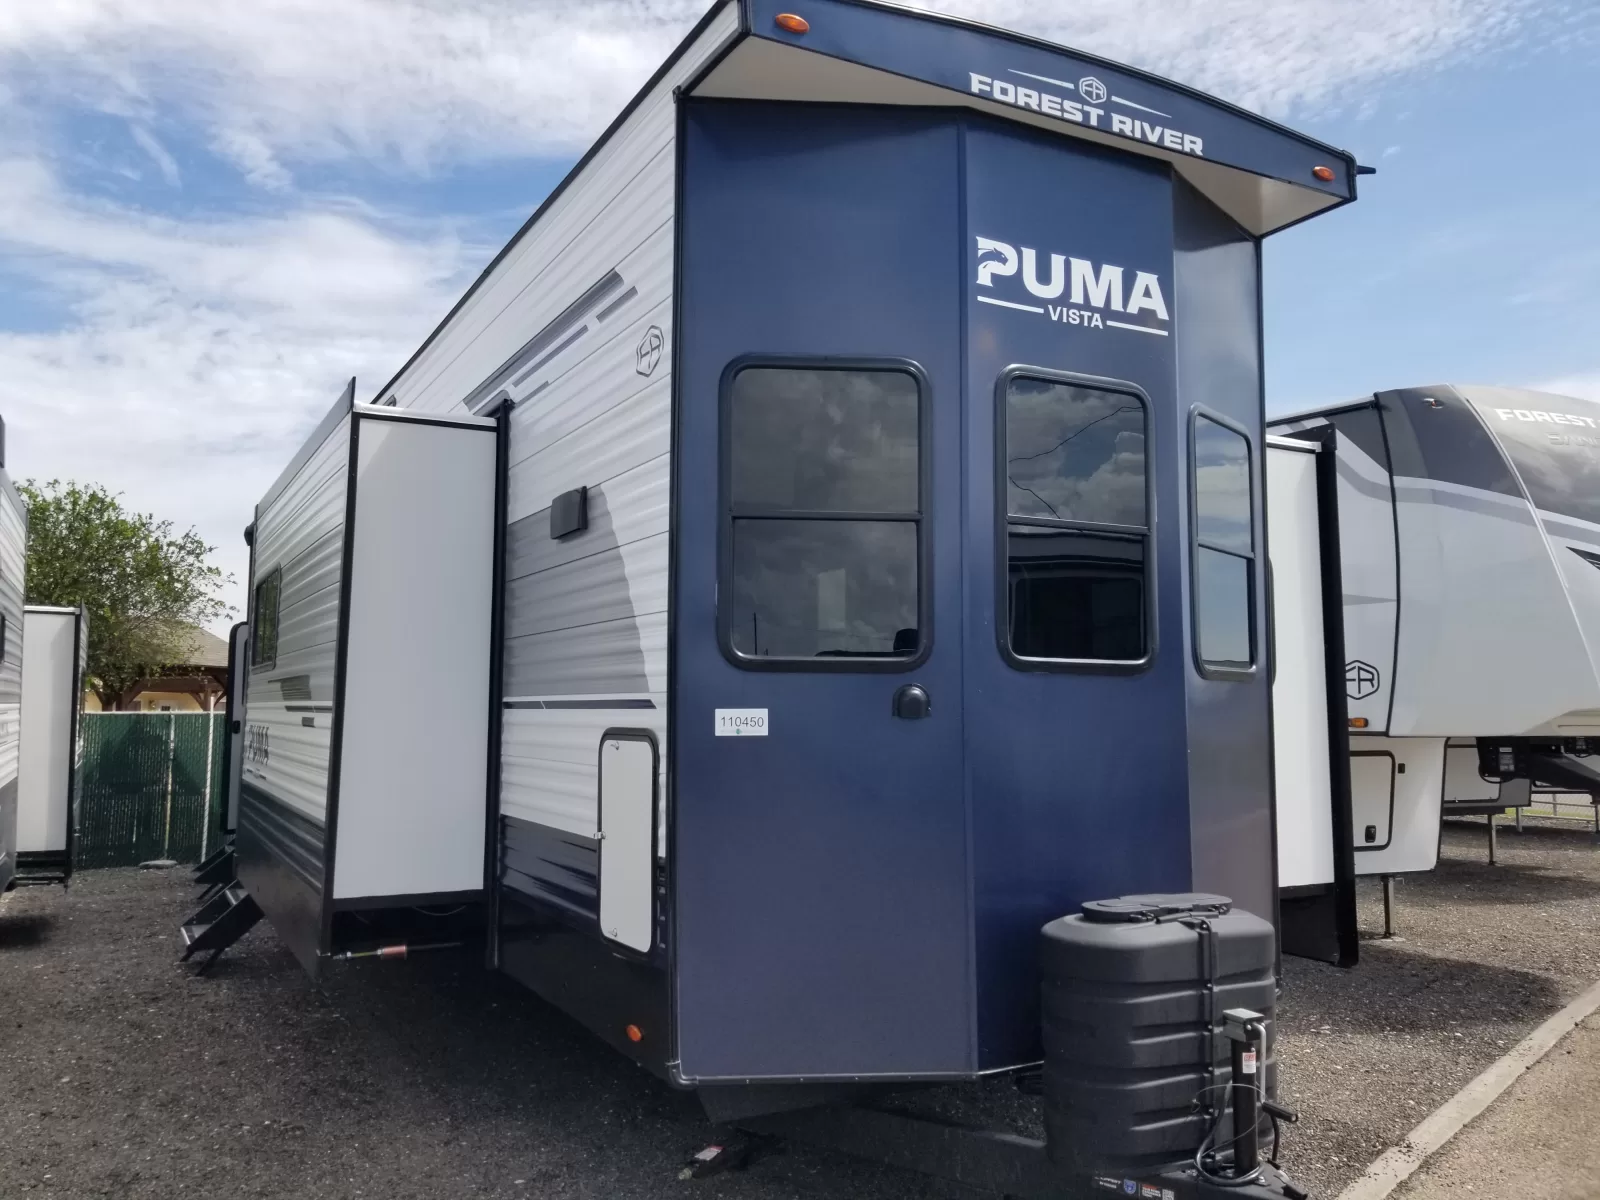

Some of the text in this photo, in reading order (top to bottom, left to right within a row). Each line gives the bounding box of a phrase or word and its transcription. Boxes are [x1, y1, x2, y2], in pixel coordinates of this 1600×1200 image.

[969, 72, 1203, 156] FOREST RIVER
[976, 236, 1169, 320] PUMA
[1048, 305, 1103, 329] VISTA
[1493, 408, 1597, 429] FOREST
[721, 716, 764, 727] 110450
